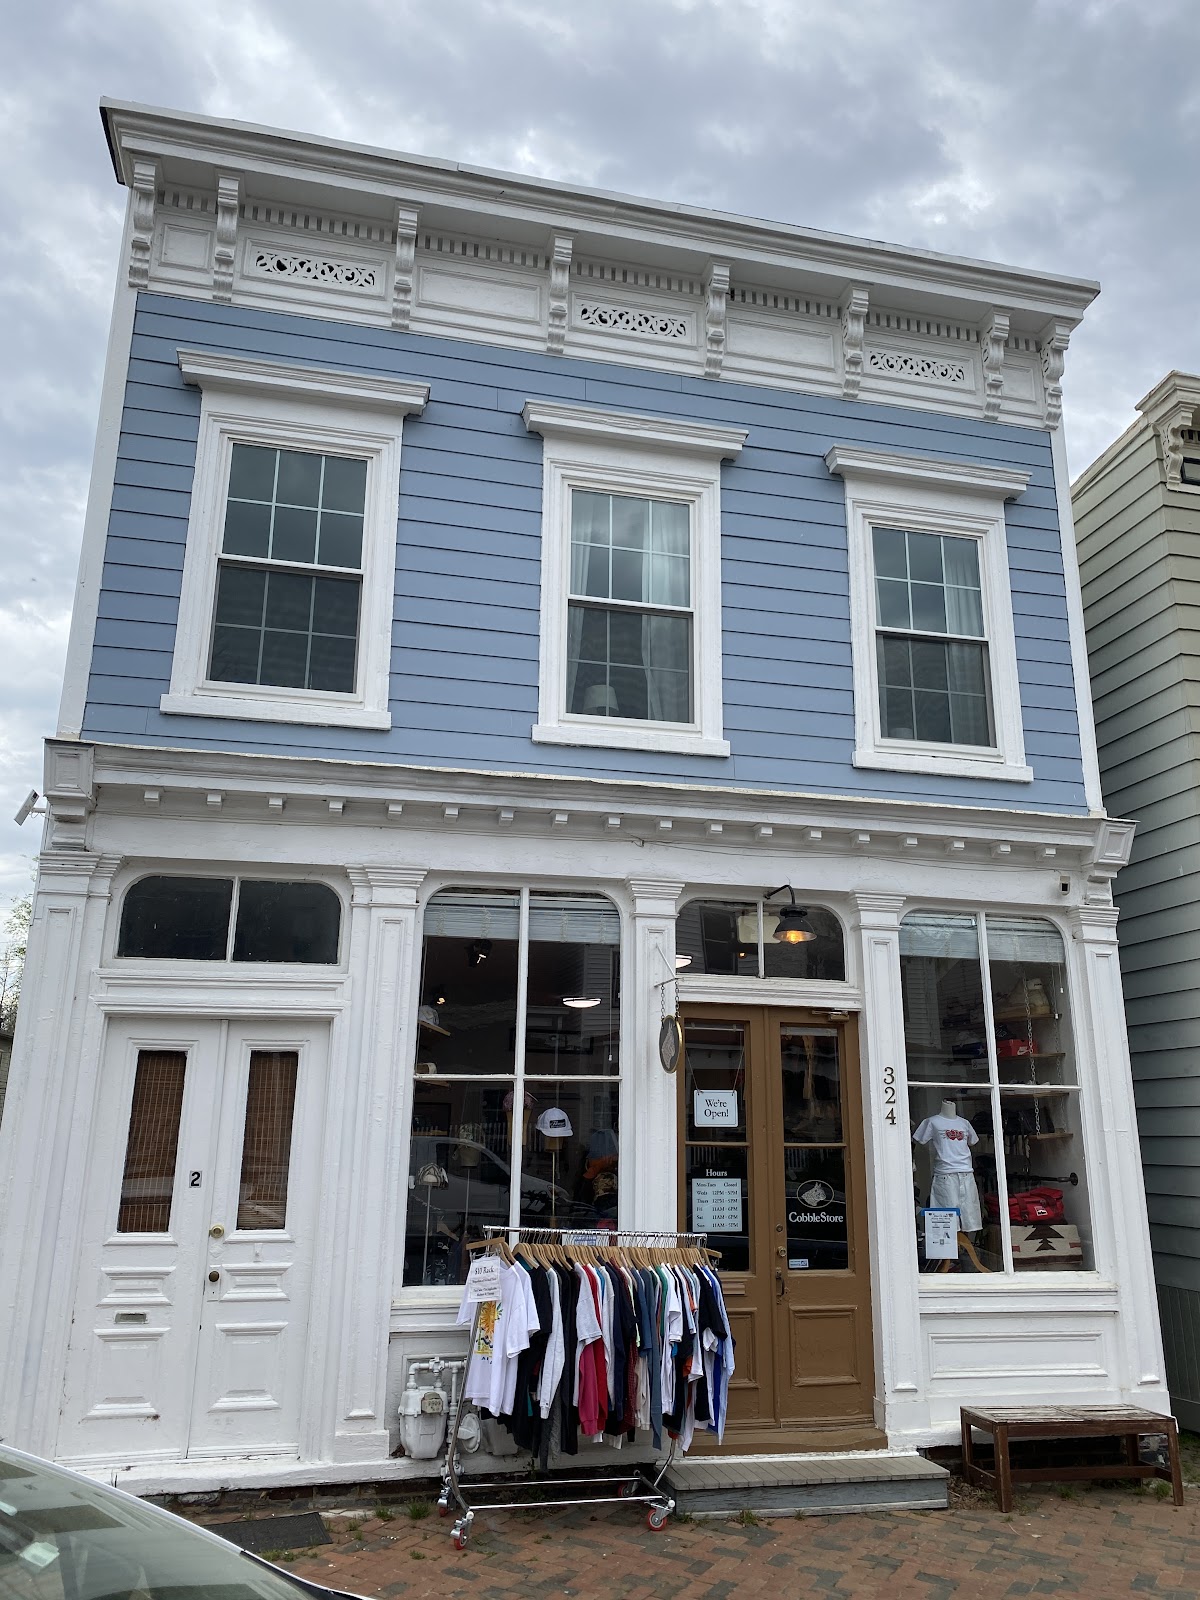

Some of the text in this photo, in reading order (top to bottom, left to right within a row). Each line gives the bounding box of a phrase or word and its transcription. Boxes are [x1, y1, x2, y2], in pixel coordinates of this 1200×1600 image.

[884, 1066, 897, 1126] 324
[705, 1099, 728, 1108] We're
[704, 1108, 729, 1120] Open!
[191, 1171, 201, 1187] 2
[705, 1169, 728, 1177] Hours
[788, 1211, 844, 1223] CobbleStore
